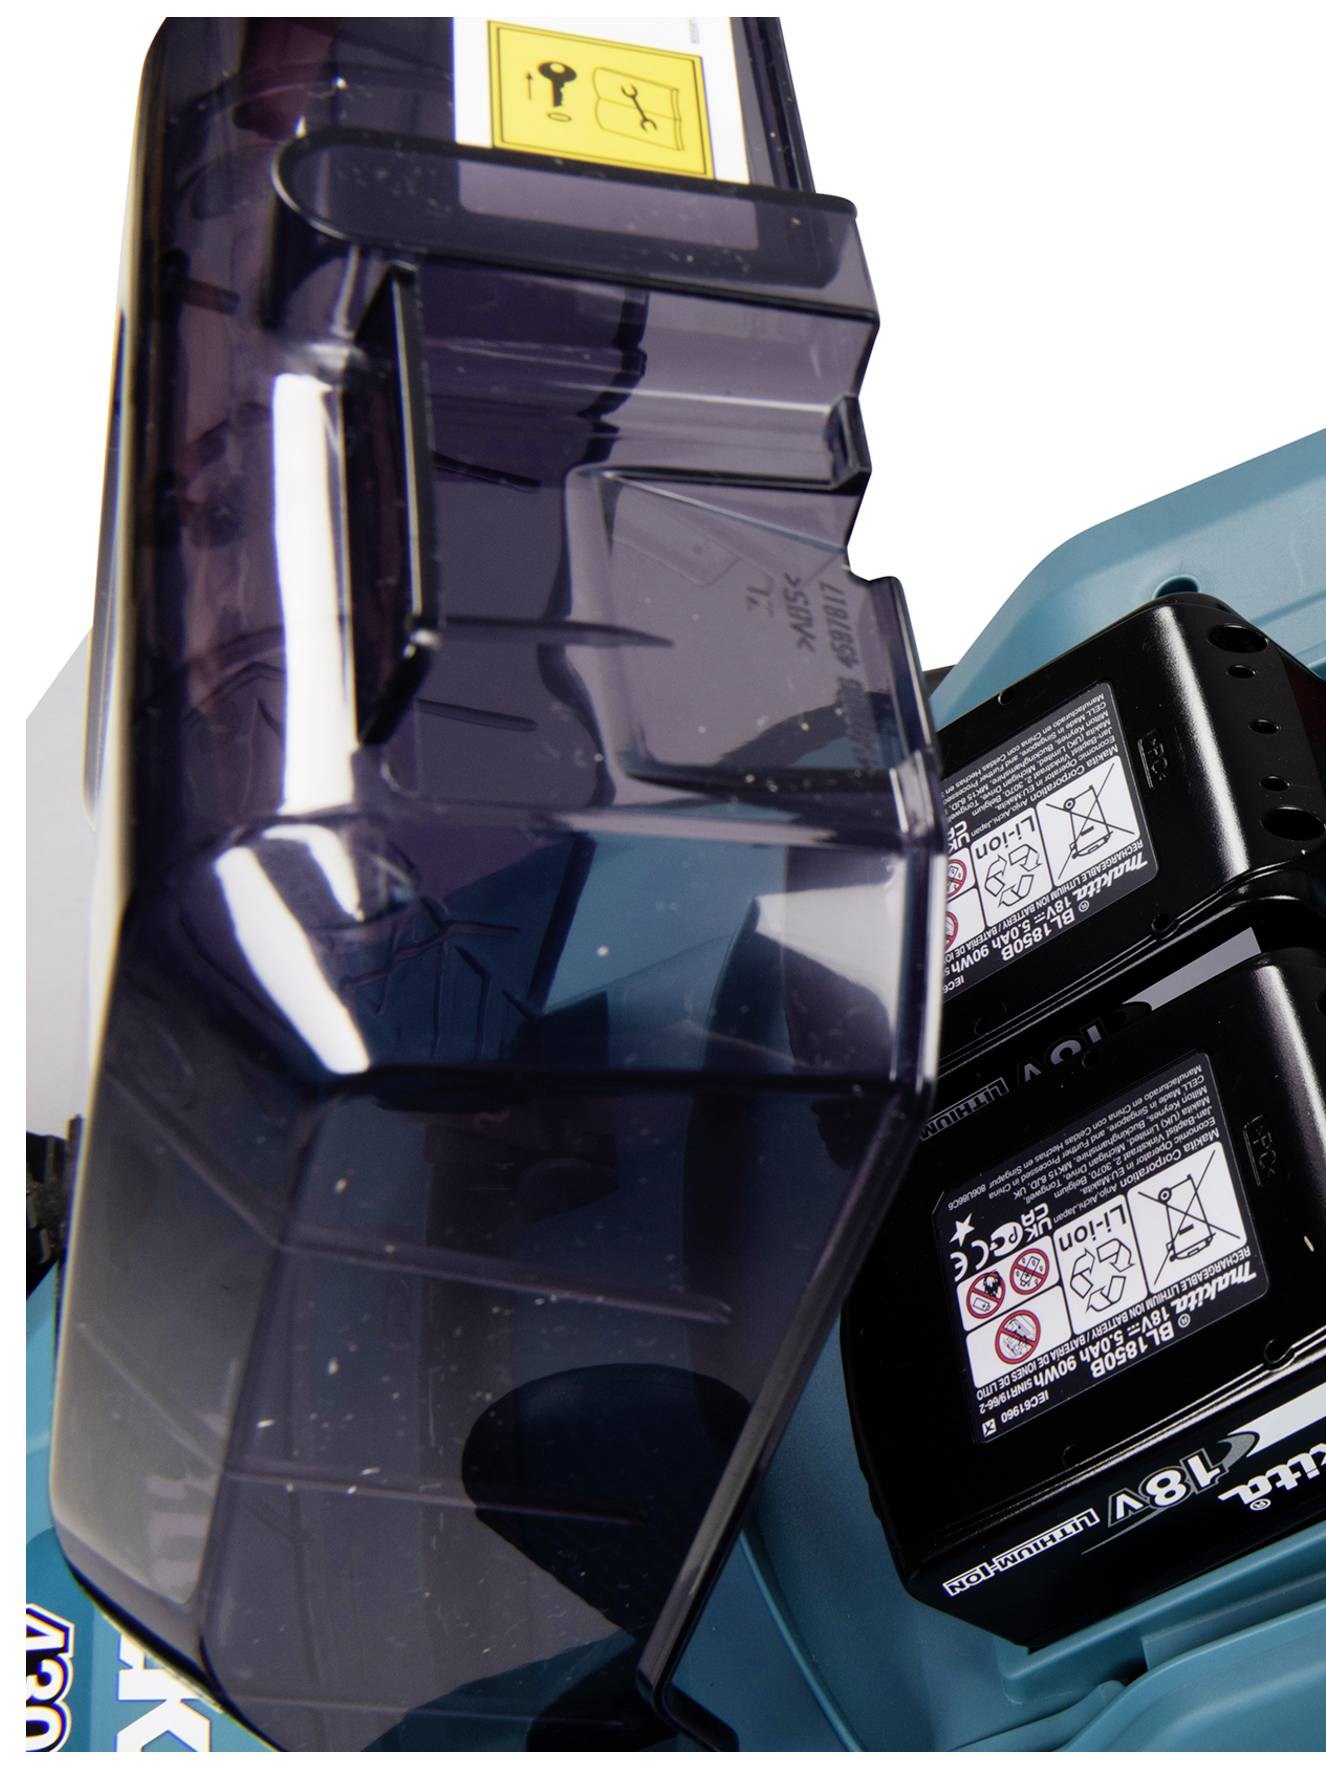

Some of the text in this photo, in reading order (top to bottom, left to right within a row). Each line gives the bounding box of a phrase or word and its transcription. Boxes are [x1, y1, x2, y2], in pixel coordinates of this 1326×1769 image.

[1065, 713, 1085, 731] Made
[1085, 700, 1106, 718] CELL
[1085, 709, 1109, 729] Milton
[1057, 726, 1064, 736] in
[1085, 717, 1111, 738] Makita
[944, 692, 1104, 794] Manufacturado en China con Celdas Hechas en
[1066, 733, 1084, 750] (UK)
[1077, 734, 1115, 763] Economic
[1004, 754, 1018, 768] and
[1032, 752, 1070, 780] Vinkstraat
[1043, 756, 1077, 783] Operator
[1086, 743, 1118, 769] Makita
[978, 763, 1004, 784] Further
[1002, 762, 1036, 789] Michigan
[1028, 762, 1085, 804] Corporation
[1035, 778, 1043, 788] in
[966, 783, 988, 802] MK15
[971, 793, 1001, 818] Belgium
[947, 797, 978, 823] Tongwel
[974, 814, 1034, 863] Li-ion
[1080, 838, 1143, 882] RECHARGEABLE
[1050, 876, 1080, 900] LITHIUM
[1071, 850, 1147, 906] makita
[1035, 894, 1049, 909] ION
[1001, 903, 1034, 929] BATTERY
[991, 918, 1030, 950] 5.0Ah
[1000, 907, 1074, 961] BL1850B
[950, 942, 989, 974] 90Wh
[954, 945, 965, 958] DE
[1157, 1087, 1181, 1106] Made
[1181, 1073, 1205, 1093] CELL
[1181, 1084, 1207, 1106] Milton
[1148, 1100, 1157, 1111] in
[1180, 1094, 1210, 1118] Makita
[988, 1063, 1202, 1191] Manufacturado en China con Celdas Hechas en Singapur
[1159, 1110, 1180, 1129] (UK)
[1164, 1104, 1213, 1138] Jan-Baptist
[1172, 1115, 1216, 1146] Economic
[1061, 1138, 1089, 1161] Further
[1089, 1129, 1106, 1145] and
[1122, 1132, 1165, 1162] Vinkstraat
[1182, 1126, 1219, 1155] Makita
[1087, 1140, 1126, 1170] Michigan
[1134, 1138, 1173, 1167] Operator
[1020, 1154, 1061, 1183] Processed
[1047, 1160, 1072, 1180] MK15
[1118, 1145, 1182, 1191] Corporation
[1125, 1161, 1134, 1173] in
[988, 1182, 1012, 1202] China
[1011, 1177, 1020, 1188] in
[1012, 1185, 1027, 1200] UK
[1052, 1174, 1087, 1201] Belgium
[1019, 1201, 1049, 1228] CA
[1023, 1215, 1052, 1242] UK
[1057, 1202, 1127, 1257] Li-ion
[1179, 1245, 1251, 1292] RECHARGEABLE
[1144, 1283, 1179, 1310] LITHIUM
[1169, 1258, 1256, 1319] makita
[1128, 1301, 1145, 1319] ION
[1090, 1310, 1128, 1340] BATTERY
[1049, 1333, 1086, 1363] BATERÍA
[1078, 1328, 1124, 1365] 5.0Ah
[1089, 1320, 1174, 1379] BL1850B
[1009, 1360, 1037, 1383] IONES
[1032, 1353, 1077, 1389] 90Wh
[1036, 1353, 1050, 1368] DE
[975, 1381, 998, 1401] LITIO
[978, 1376, 1033, 1415] 5INR19/66-2
[996, 1374, 1011, 1390] DE
[999, 1388, 1049, 1423] IEC61960
[943, 1451, 1228, 1597] 18V LITHIUM-ION
